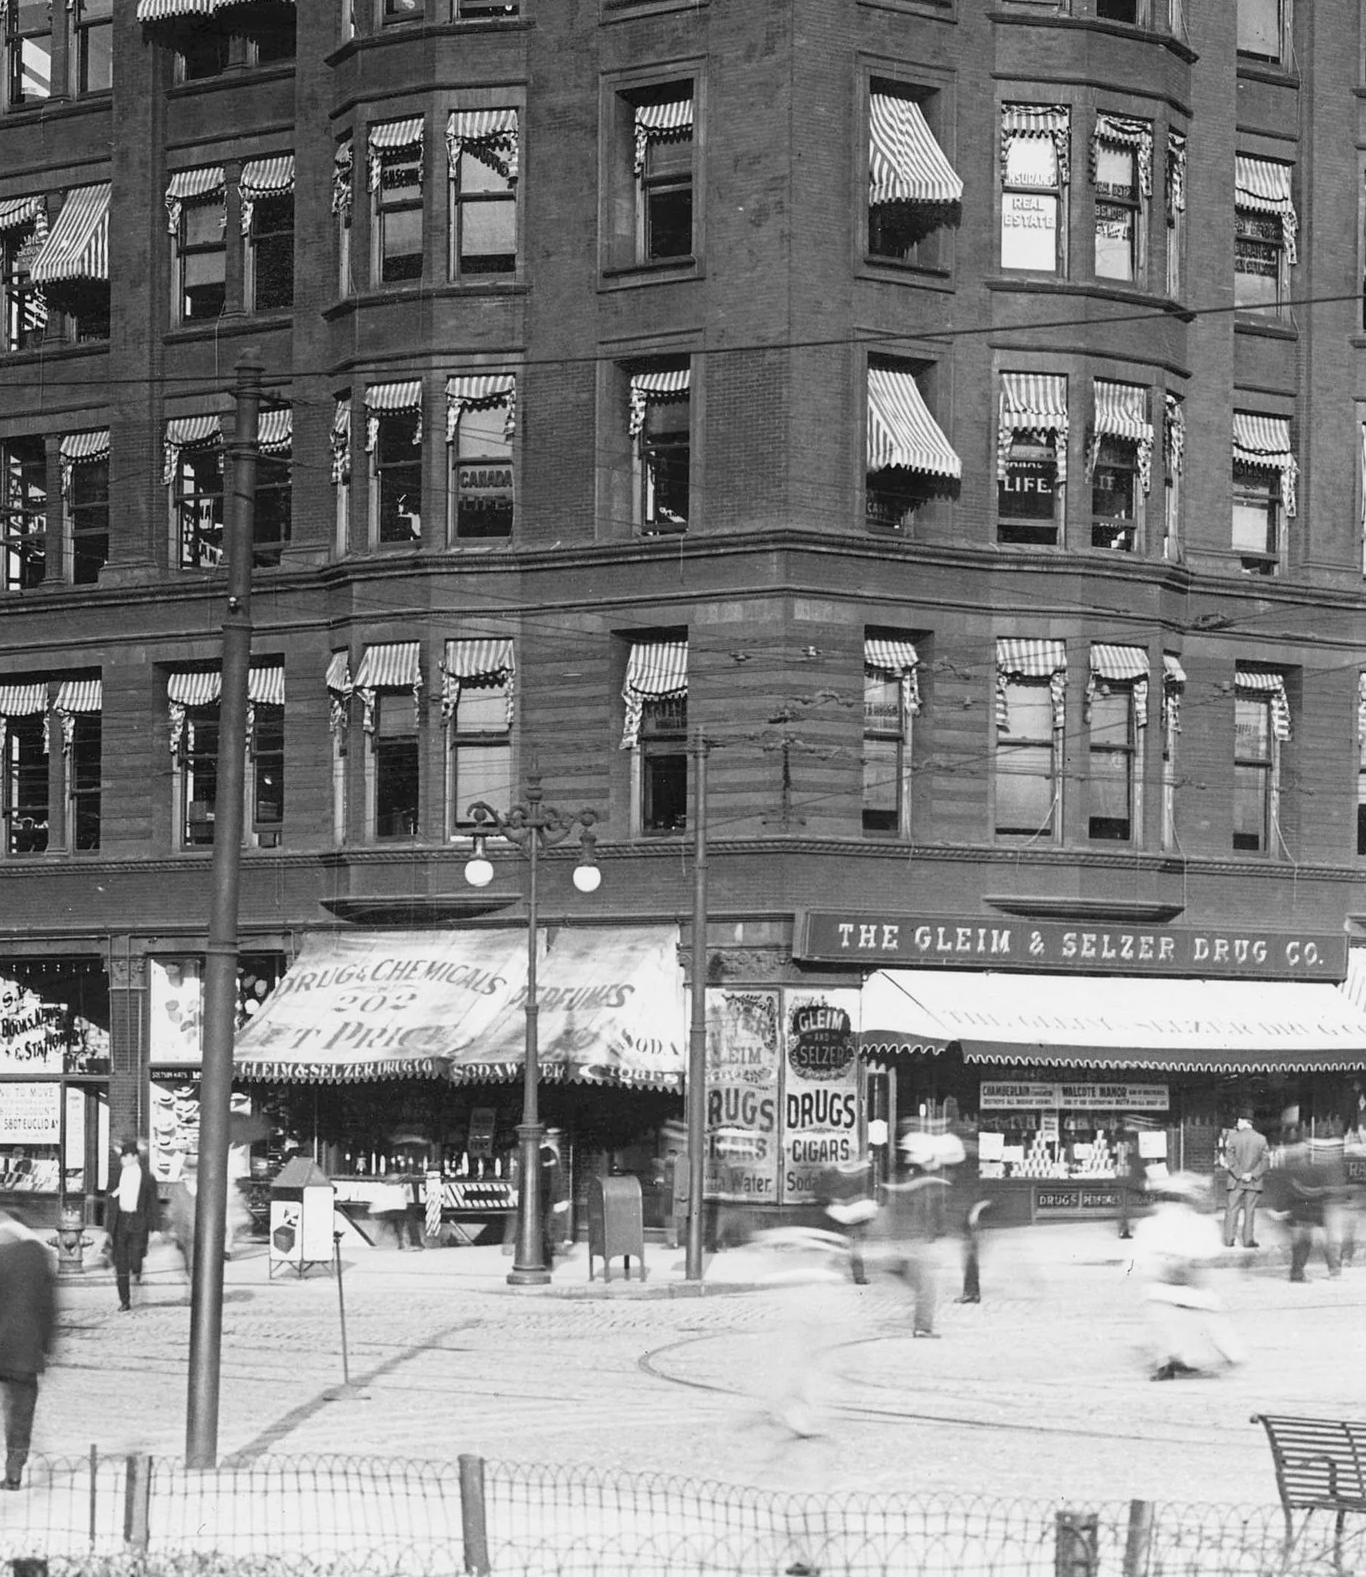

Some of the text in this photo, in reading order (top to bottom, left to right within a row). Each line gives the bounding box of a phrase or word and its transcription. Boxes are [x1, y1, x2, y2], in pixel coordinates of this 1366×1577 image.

[1012, 197, 1044, 212] REAL
[1003, 214, 1056, 230] ESTATE
[459, 469, 514, 488] CANADA
[1004, 476, 1053, 494] LIFE.
[838, 923, 1325, 967] THE GLEIM & SELZER DRUG CO.
[797, 1009, 845, 1032] GLEIM
[798, 1045, 846, 1066] SELZER
[240, 1060, 293, 1078] GLEIM
[308, 1062, 375, 1079] SELZER
[452, 1063, 500, 1079] SODA
[499, 1061, 567, 1079] WER
[707, 1086, 776, 1133] RUGS
[786, 1088, 856, 1129] DRUGS
[22, 1118, 50, 1130] EUCLID
[791, 1138, 850, 1163] CIGARS
